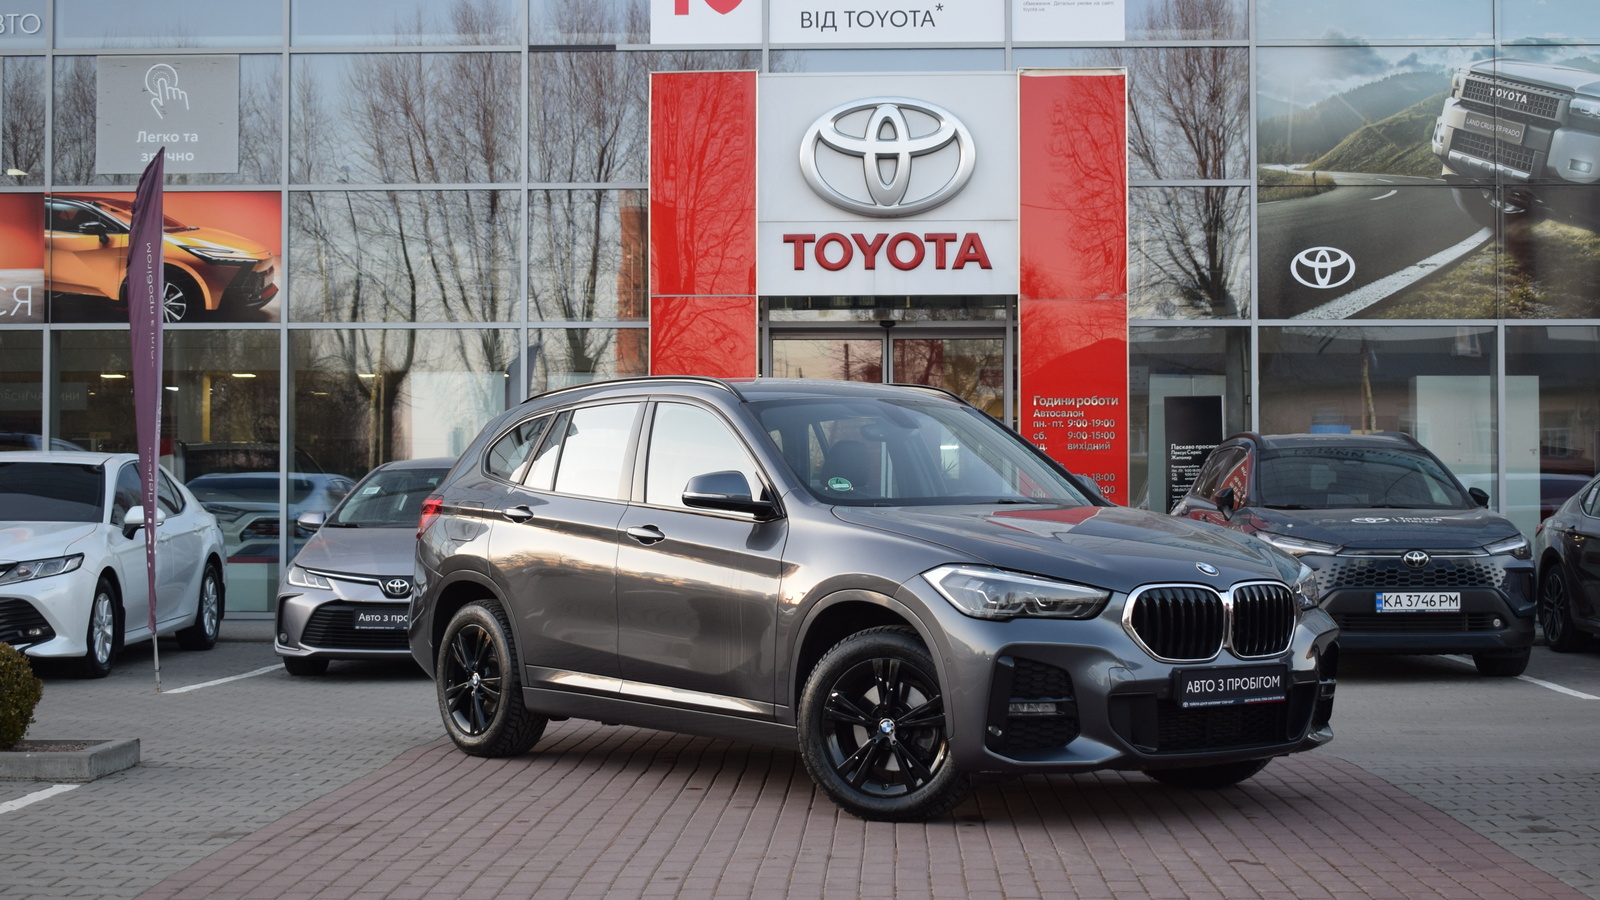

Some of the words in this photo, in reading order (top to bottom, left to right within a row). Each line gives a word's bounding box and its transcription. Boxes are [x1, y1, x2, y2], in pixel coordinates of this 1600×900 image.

[800, 10, 838, 33] ВІД
[1490, 88, 1527, 103] TOYOTA
[1466, 118, 1480, 127] LAND
[1502, 127, 1520, 137] PRADO
[136, 130, 180, 143] Легко
[183, 133, 198, 142] та
[783, 232, 993, 271] TOYOTA
[1033, 396, 1075, 407] Години
[1076, 395, 1119, 409] роботи
[1033, 409, 1084, 418] Автосалон
[1033, 431, 1047, 441] сб.
[1067, 442, 1111, 451] вихідний
[1383, 594, 1403, 608] KA
[1406, 594, 1436, 608] 3746
[1439, 594, 1459, 608] PM
[358, 613, 381, 622] Авто
[383, 614, 389, 622] з
[391, 615, 408, 623] про
[1186, 680, 1216, 693] АВТО
[1217, 679, 1224, 692] З
[1226, 675, 1280, 691] ПРОБІГОМ
